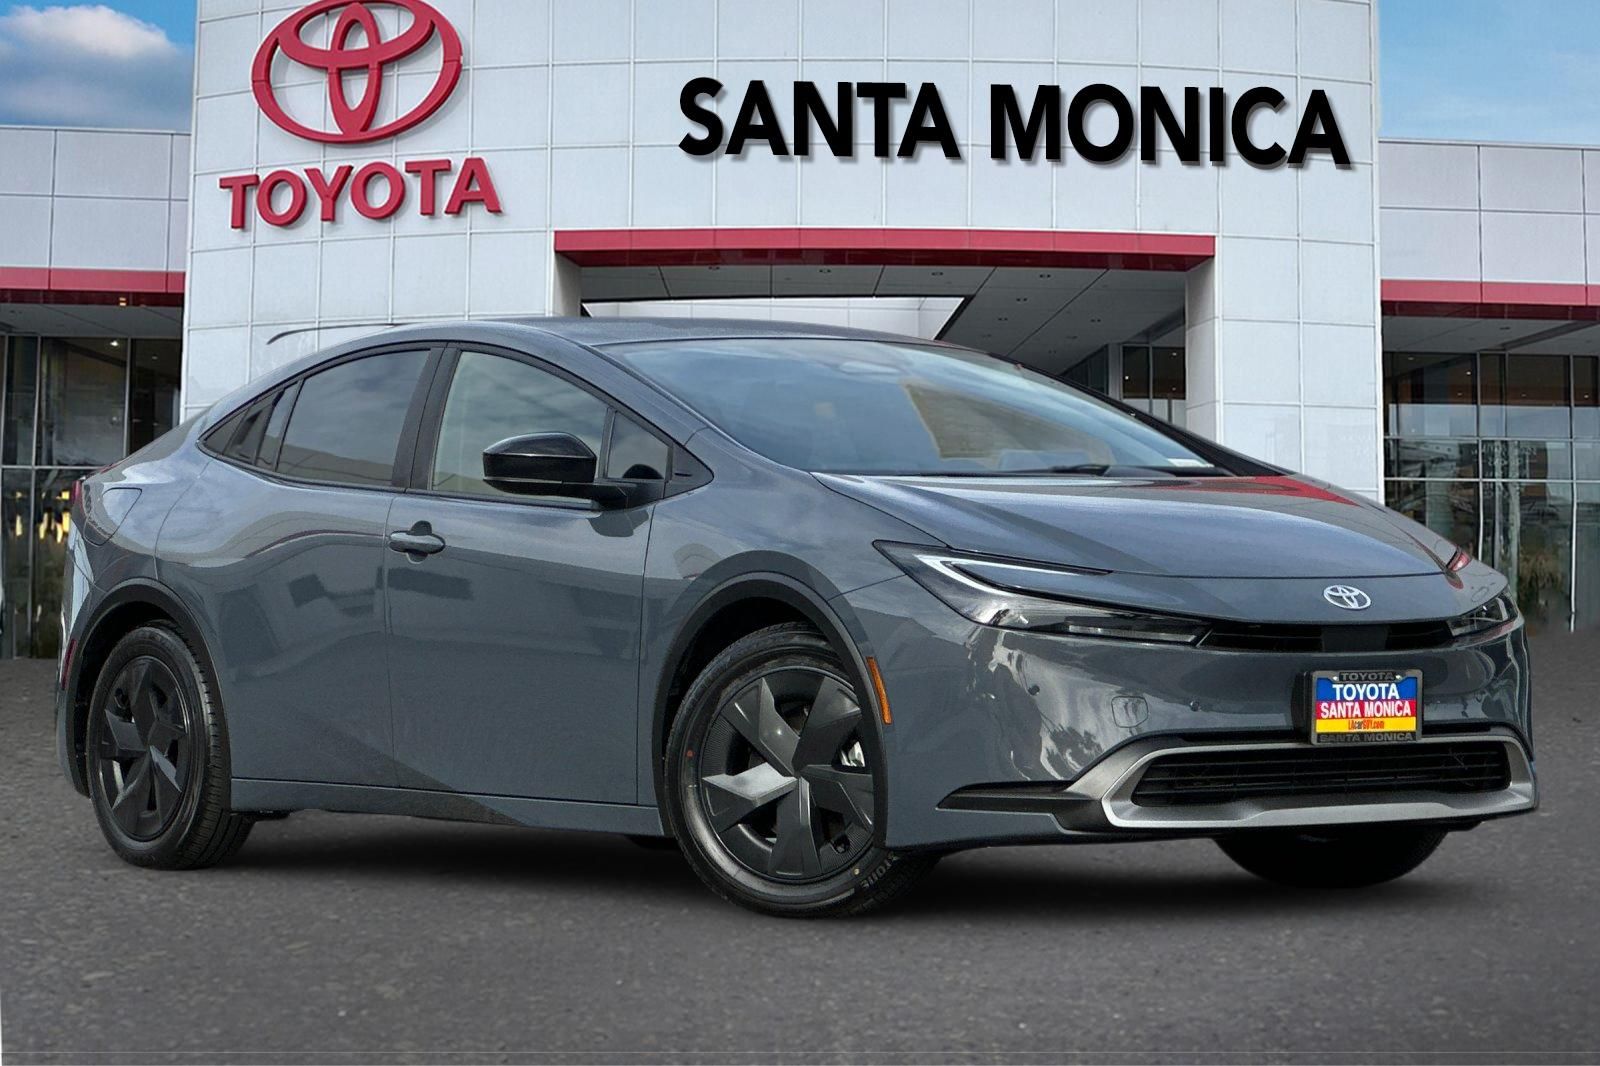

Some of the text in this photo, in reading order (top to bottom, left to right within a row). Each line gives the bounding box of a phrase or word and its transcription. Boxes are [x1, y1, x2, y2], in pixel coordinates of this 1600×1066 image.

[678, 77, 1352, 169] SANTA MONICA
[219, 157, 503, 230] TOYOTA
[1341, 671, 1395, 681] TOYOTA
[1332, 683, 1400, 700] TOYOTA
[1320, 700, 1412, 719] SANTA MONICA
[1320, 732, 1413, 742] SANTA MONICA
